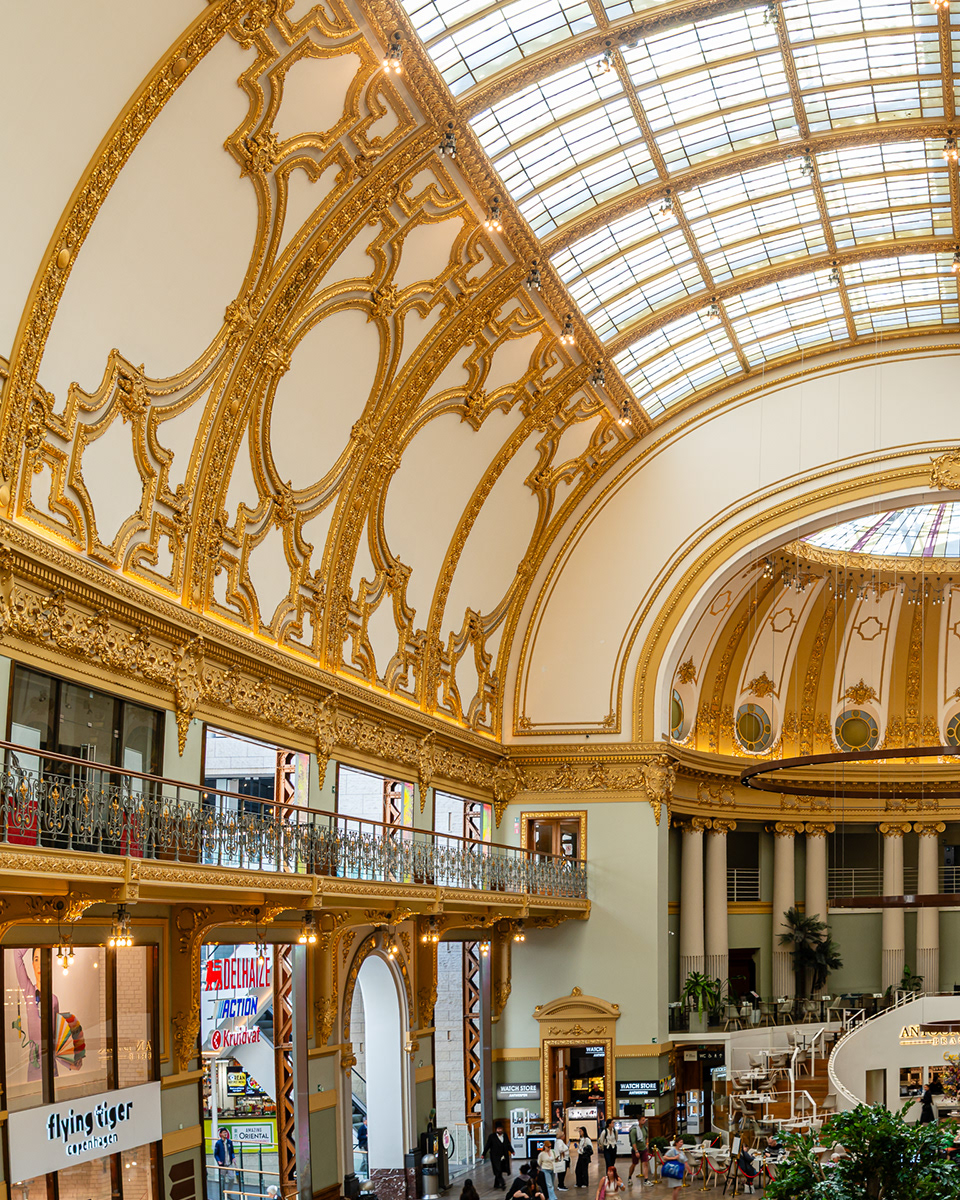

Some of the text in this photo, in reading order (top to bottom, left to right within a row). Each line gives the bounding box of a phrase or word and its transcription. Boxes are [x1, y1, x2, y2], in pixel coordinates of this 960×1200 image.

[223, 957, 271, 990] DELHAIZE
[222, 997, 258, 1018] ACTION
[223, 1025, 261, 1048] Kruidvat
[46, 1101, 134, 1143] flying tiger
[65, 1133, 119, 1156] copenhagen
